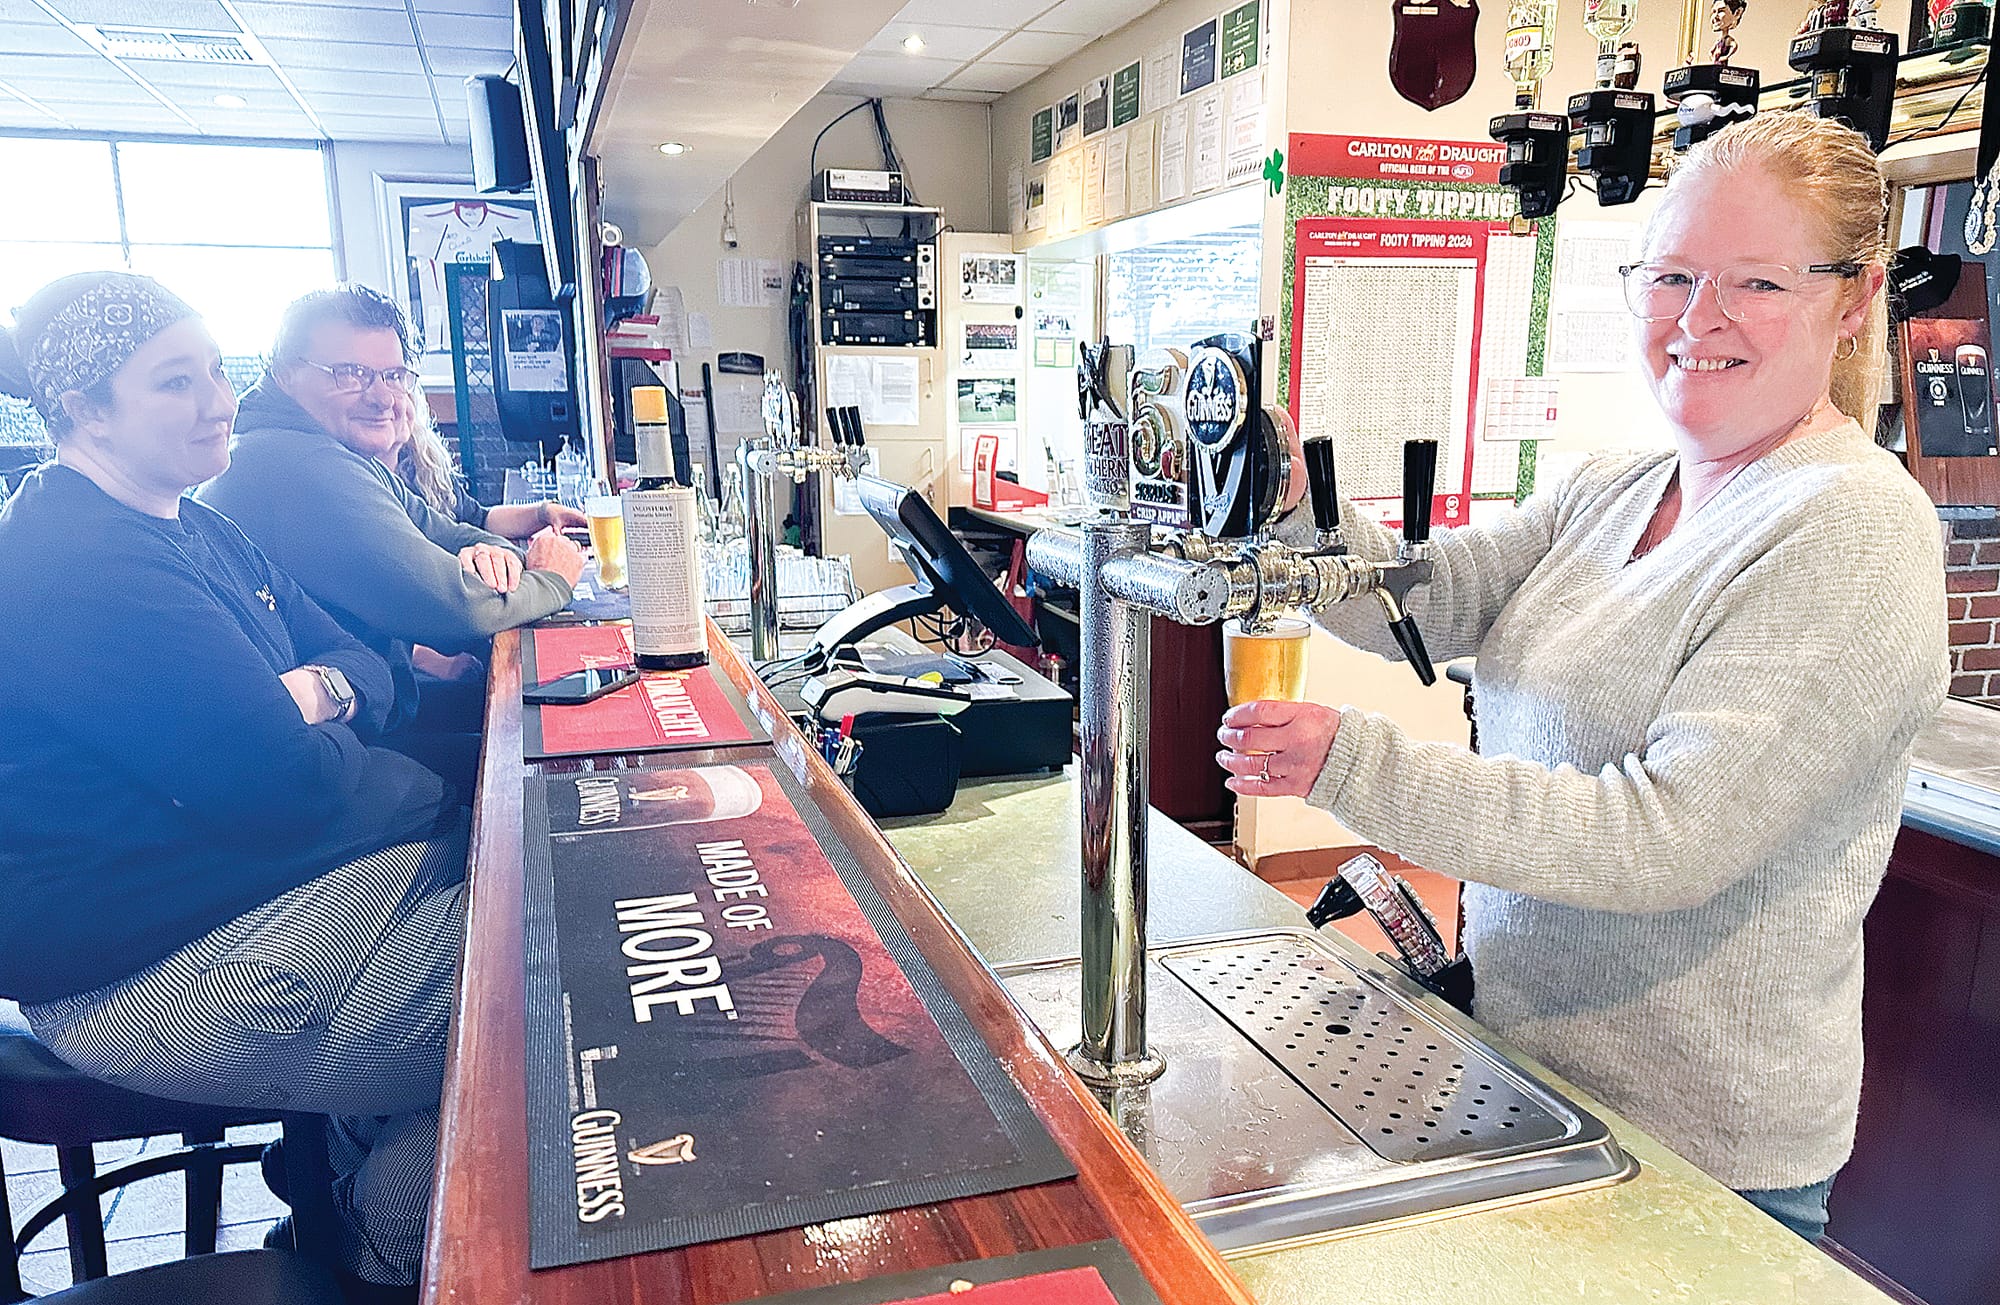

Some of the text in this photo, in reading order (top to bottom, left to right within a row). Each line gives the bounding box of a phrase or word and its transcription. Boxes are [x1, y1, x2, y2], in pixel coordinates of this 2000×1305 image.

[1347, 141, 1507, 163] CARLTON DRAUGHT
[1379, 163, 1409, 173] OFFICIAL
[1410, 164, 1426, 174] BEER
[1427, 165, 1437, 174] OF
[1437, 165, 1449, 175] THE
[1327, 186, 1516, 217] FOOTY TIPPING
[1309, 232, 1377, 240] CARLTON DRAUGHT
[1380, 233, 1473, 248] FOOTY TIPPING 2024
[1917, 361, 1954, 374] GUINNESS
[1187, 389, 1233, 422] GUINNESS
[1136, 506, 1157, 521] CRISP
[643, 679, 711, 738] DRAUGHT
[574, 776, 621, 826] GUINNESS
[695, 839, 773, 932] MADE OF
[571, 1109, 626, 1224] GUINNESS
